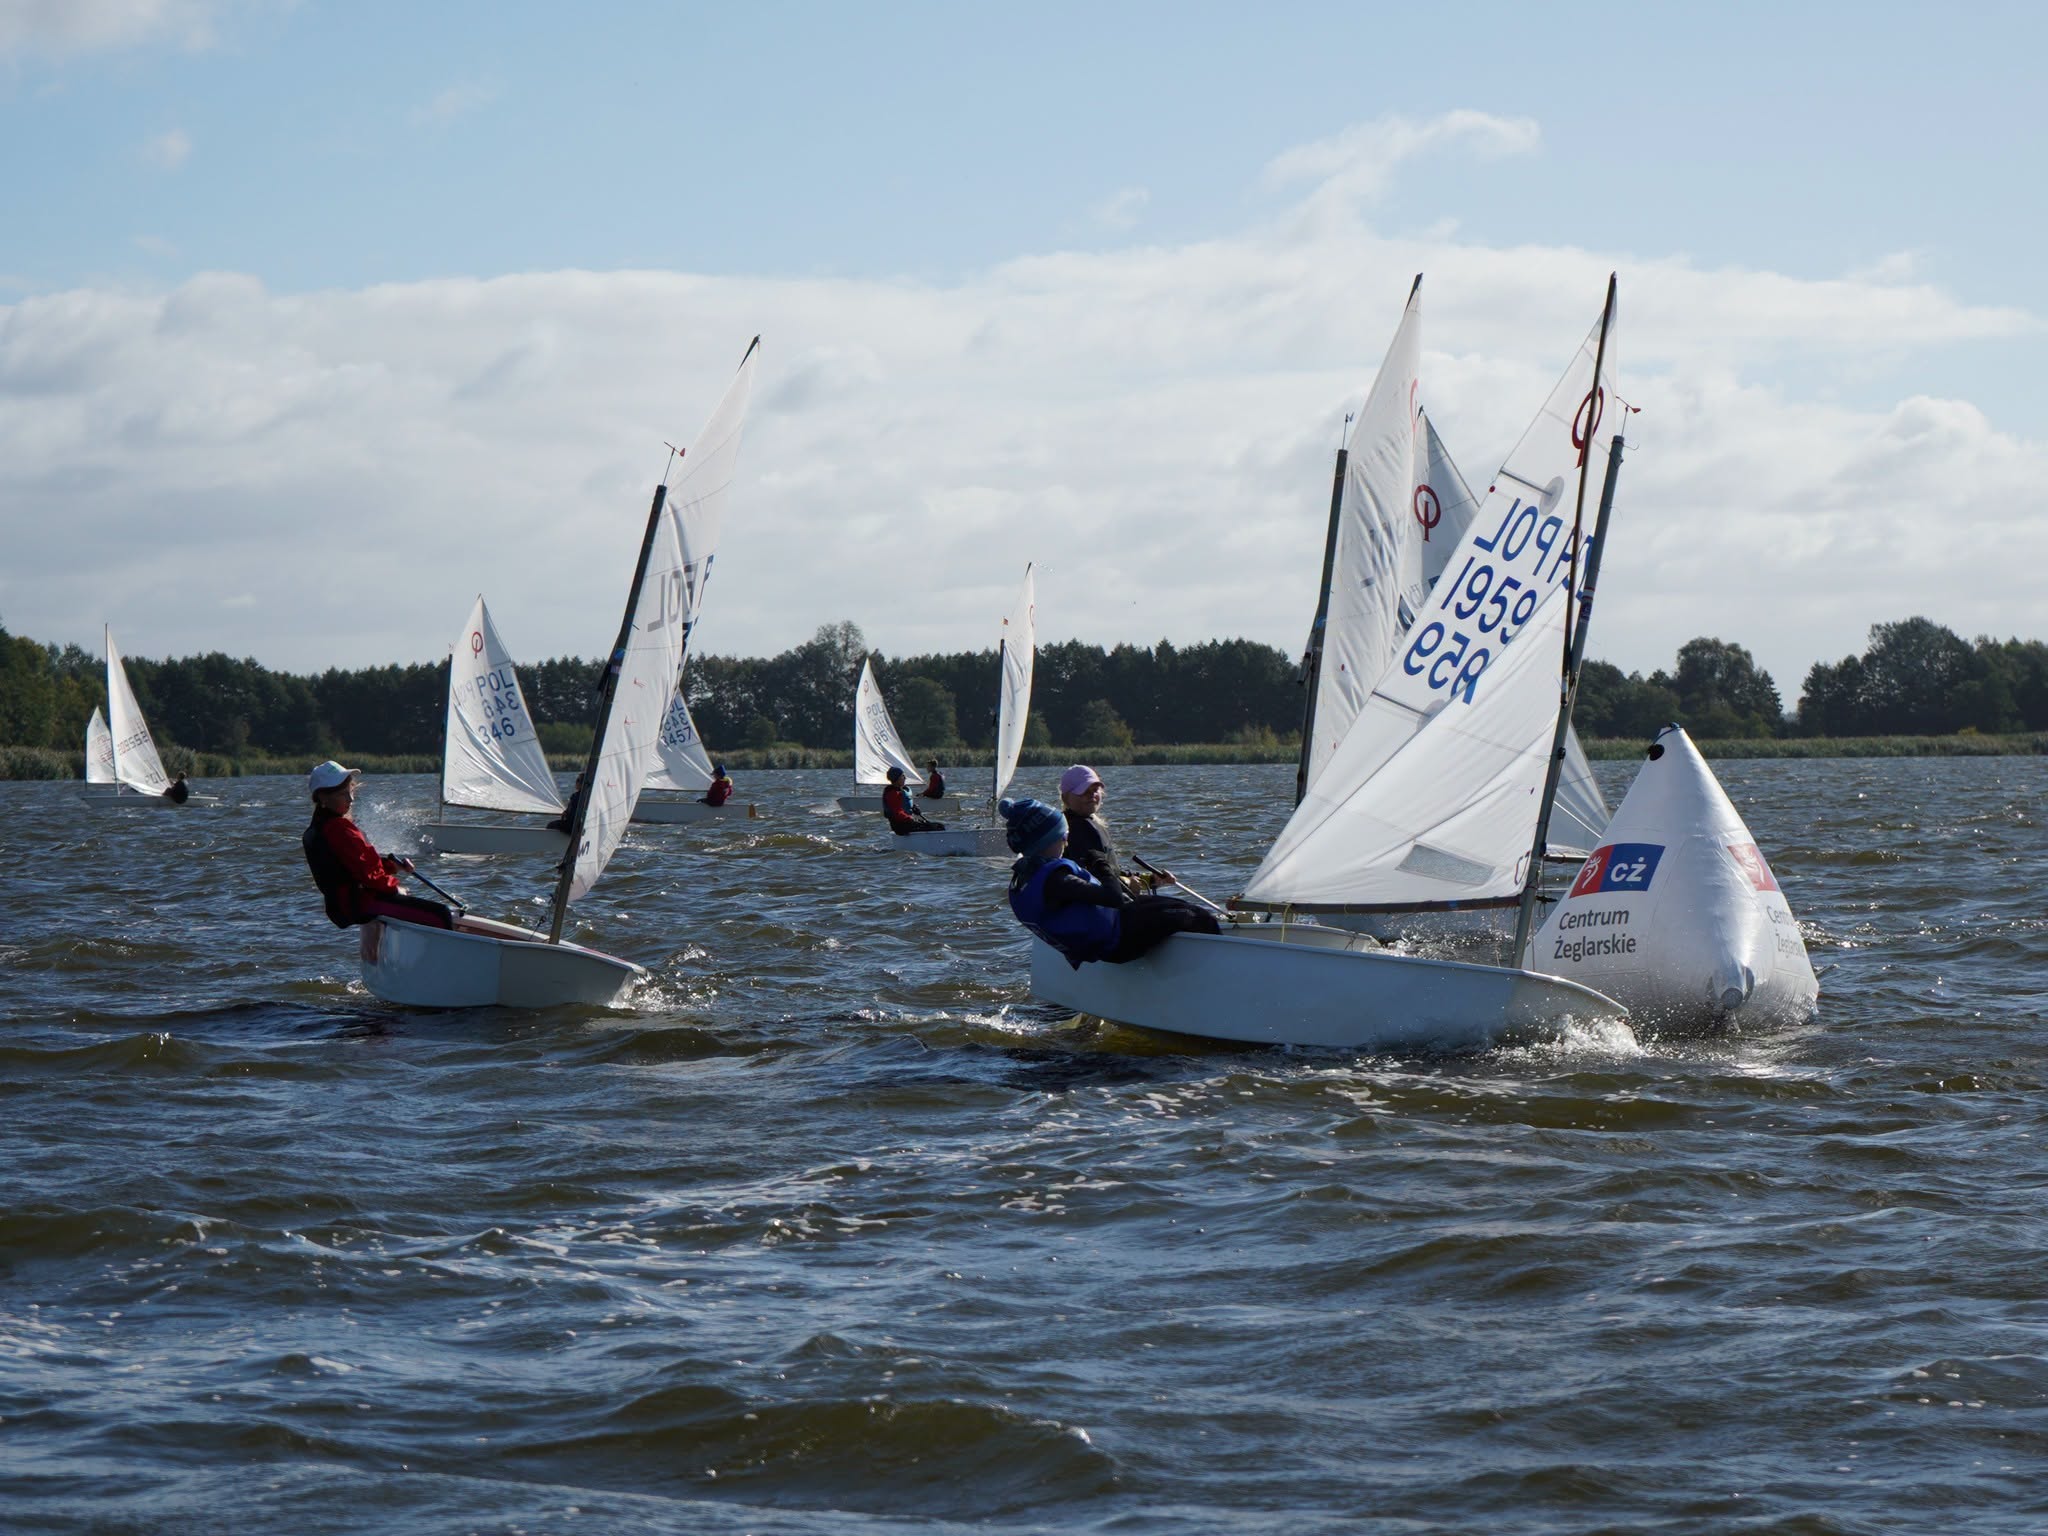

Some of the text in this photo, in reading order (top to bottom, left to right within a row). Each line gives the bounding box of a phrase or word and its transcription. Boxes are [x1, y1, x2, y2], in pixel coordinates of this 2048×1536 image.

[1441, 556, 1537, 645] 1959
[476, 669, 514, 697] POL
[478, 717, 515, 745] 346
[1610, 856, 1648, 883] CŻ
[1558, 909, 1631, 931] Centrum
[1553, 933, 1637, 962] Żeglarskie
